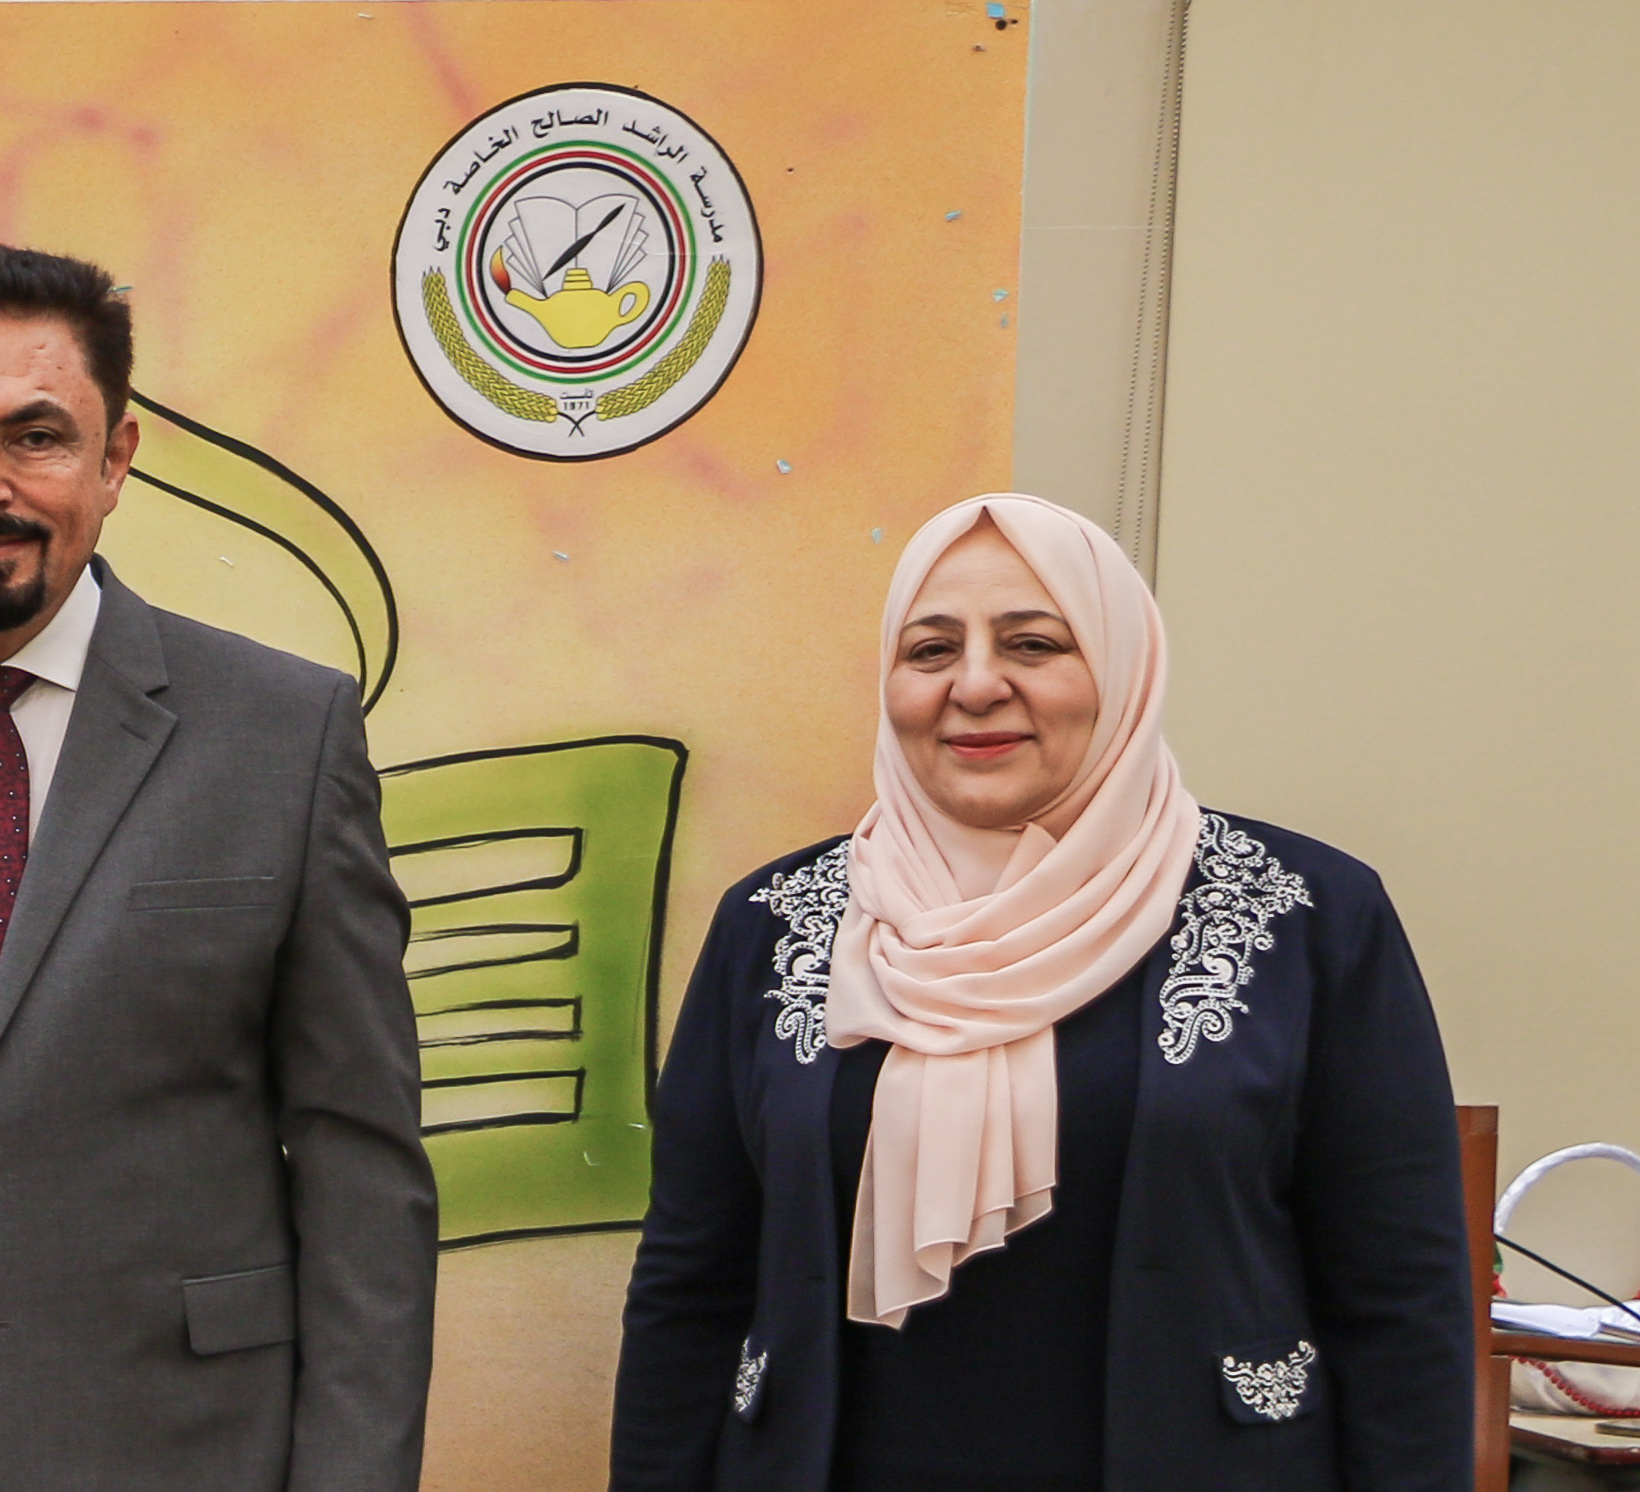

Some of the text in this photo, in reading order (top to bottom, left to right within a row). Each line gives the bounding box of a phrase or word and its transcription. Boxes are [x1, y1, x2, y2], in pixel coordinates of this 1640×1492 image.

[434, 107, 723, 251] مدرسة الراشد الصالح الخاصة دبي
[563, 401, 590, 411] 1971
